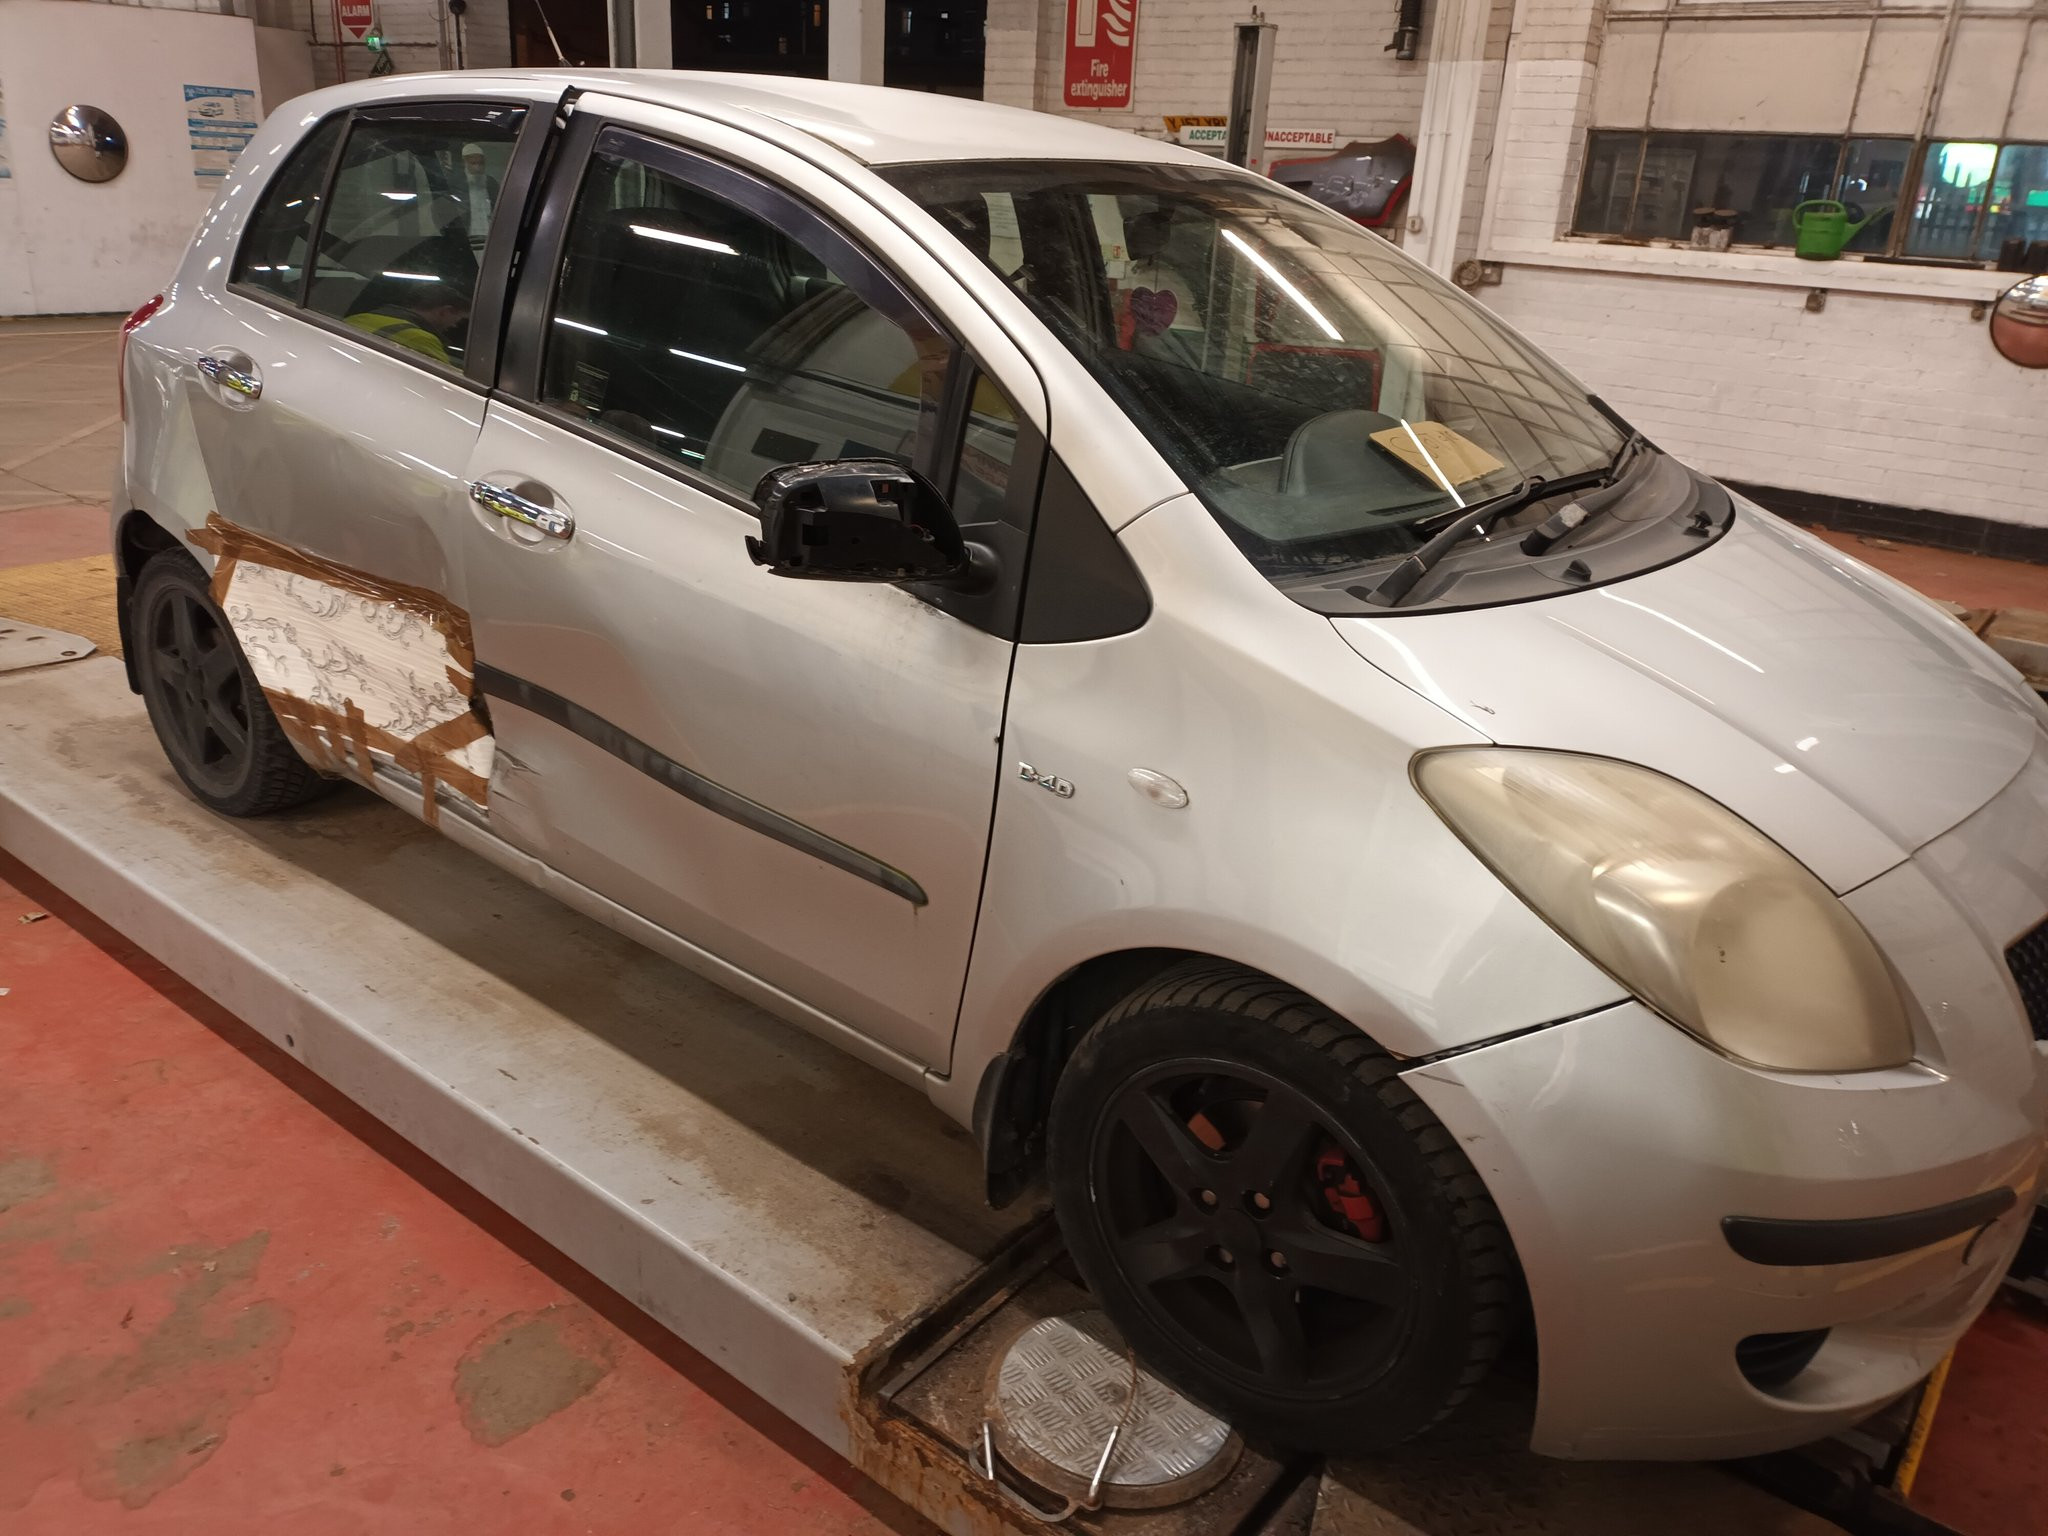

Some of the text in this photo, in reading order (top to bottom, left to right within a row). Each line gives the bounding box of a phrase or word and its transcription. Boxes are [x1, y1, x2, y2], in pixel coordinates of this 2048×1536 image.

[342, 4, 370, 17] ALARM
[1090, 58, 1109, 77] Fire
[1071, 79, 1128, 101] extinguisher
[1017, 761, 1075, 799] D-4D
